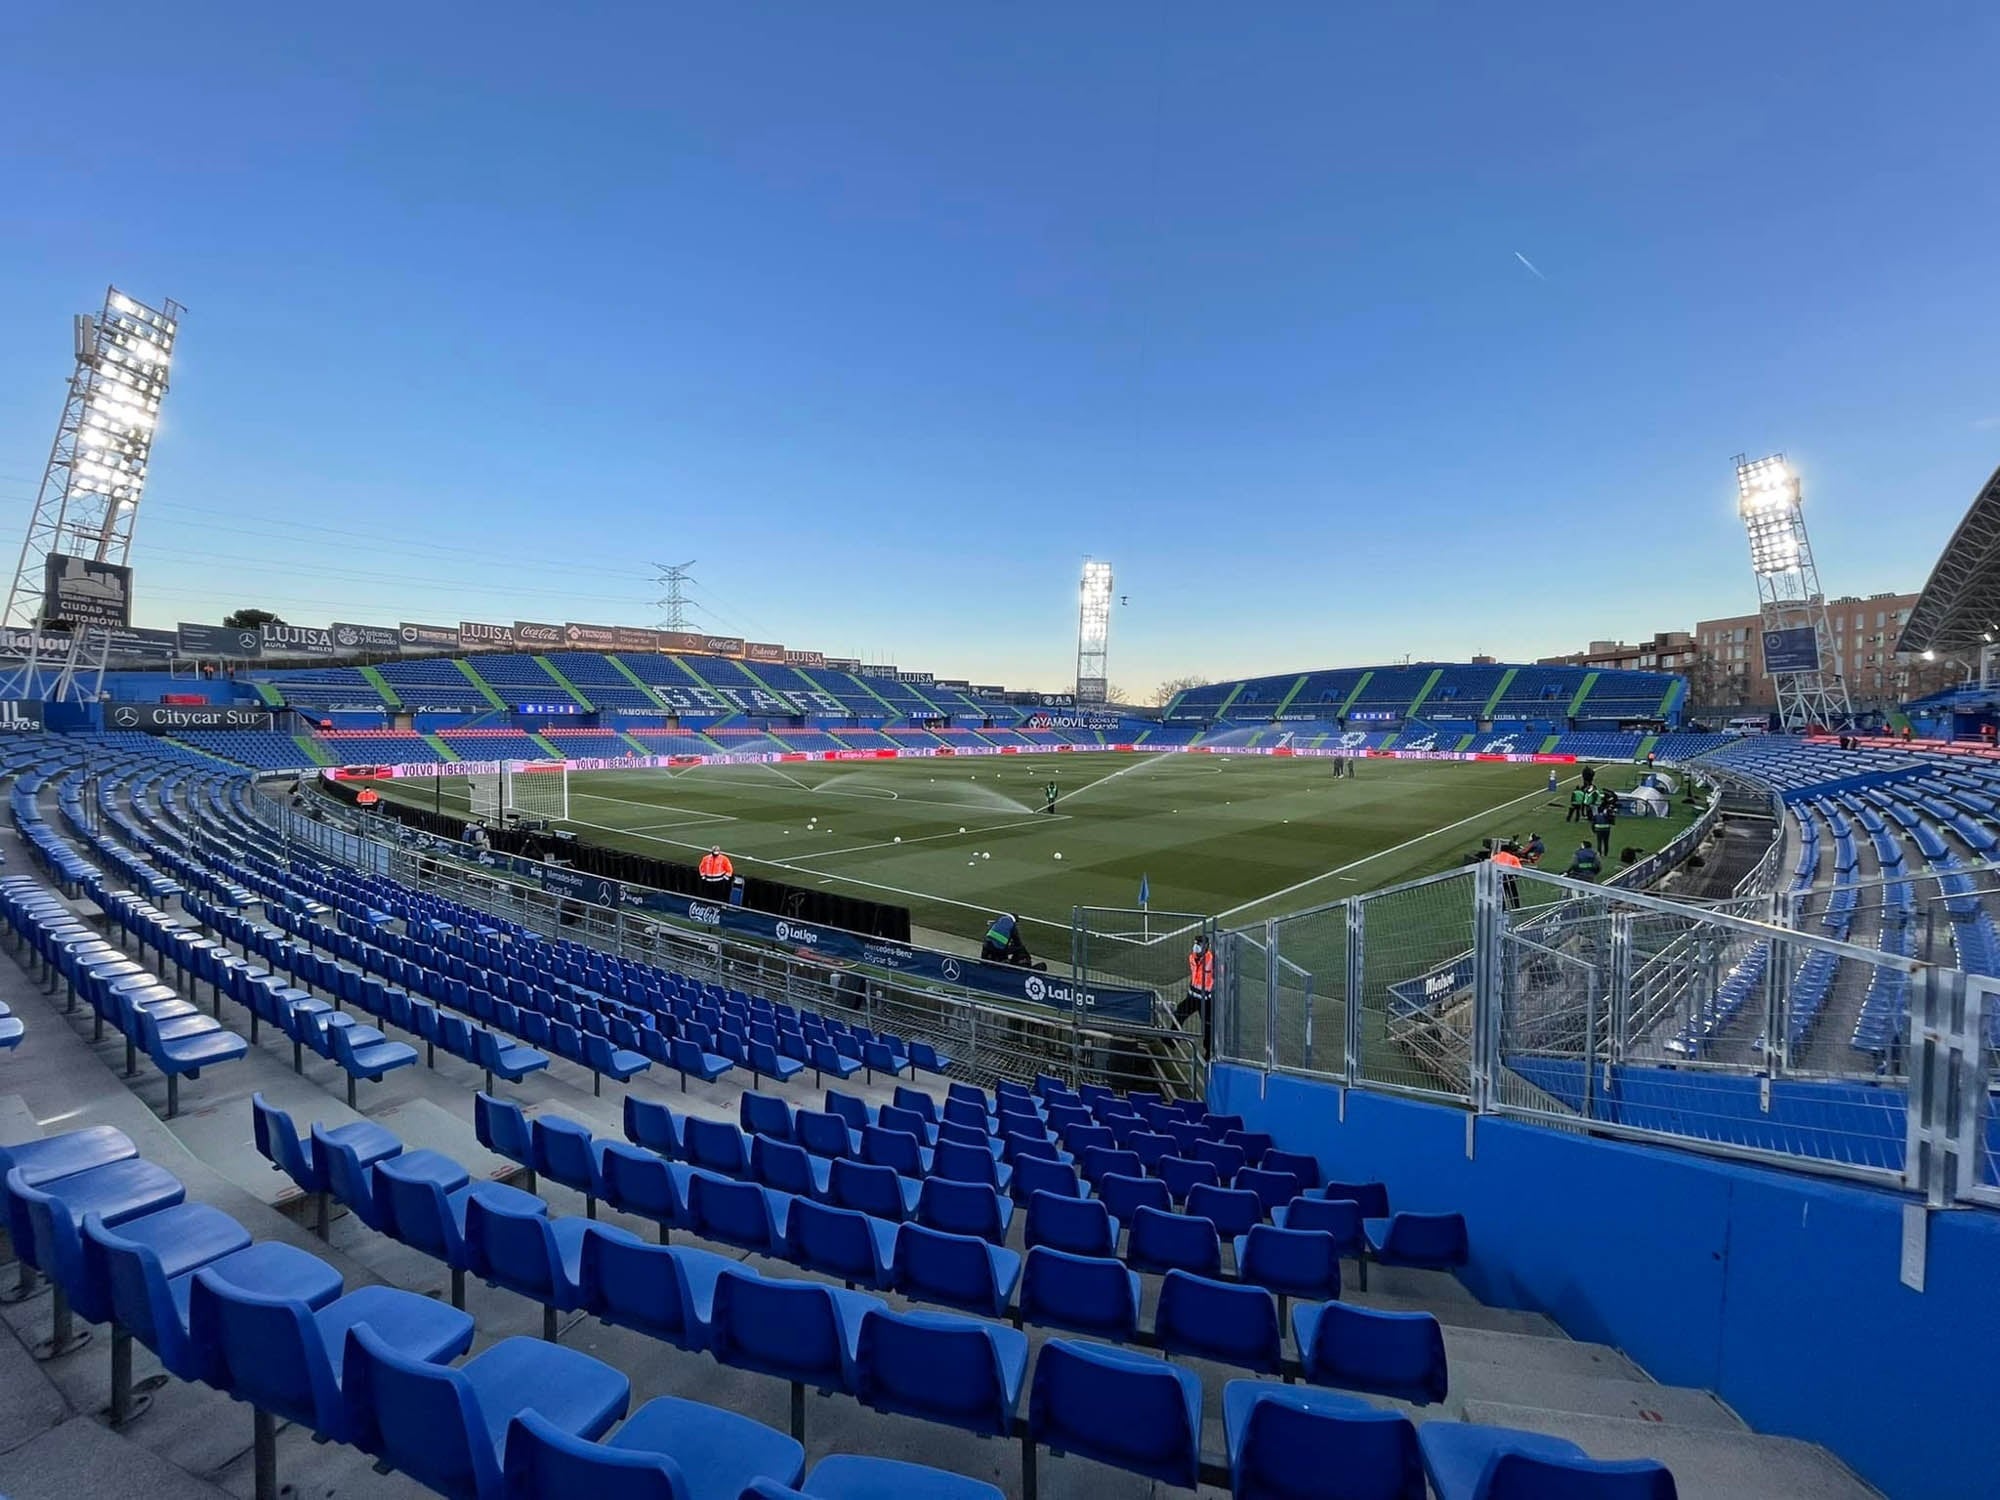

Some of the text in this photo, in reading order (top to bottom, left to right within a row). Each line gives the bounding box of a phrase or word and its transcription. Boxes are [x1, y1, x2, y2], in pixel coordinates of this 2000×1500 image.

[61, 601, 103, 614] CIUDAD
[57, 612, 124, 627] AUTOMÓVIL
[262, 625, 332, 646] LUJISA
[359, 628, 392, 638] Antonio
[461, 624, 512, 640] LUJISA
[785, 651, 822, 663] LUJISA
[899, 673, 933, 683] LUJISA
[652, 686, 848, 709] GETAFE
[152, 709, 257, 728] Citycar Sur
[1040, 717, 1087, 728] YAMOVIL
[402, 765, 433, 776] VOLVO
[575, 758, 646, 769] VOLVO TIBERMOTOR
[790, 927, 818, 943] LaLiga
[864, 943, 913, 959] Mercedes-Benz
[863, 952, 899, 967] Citycar Sur
